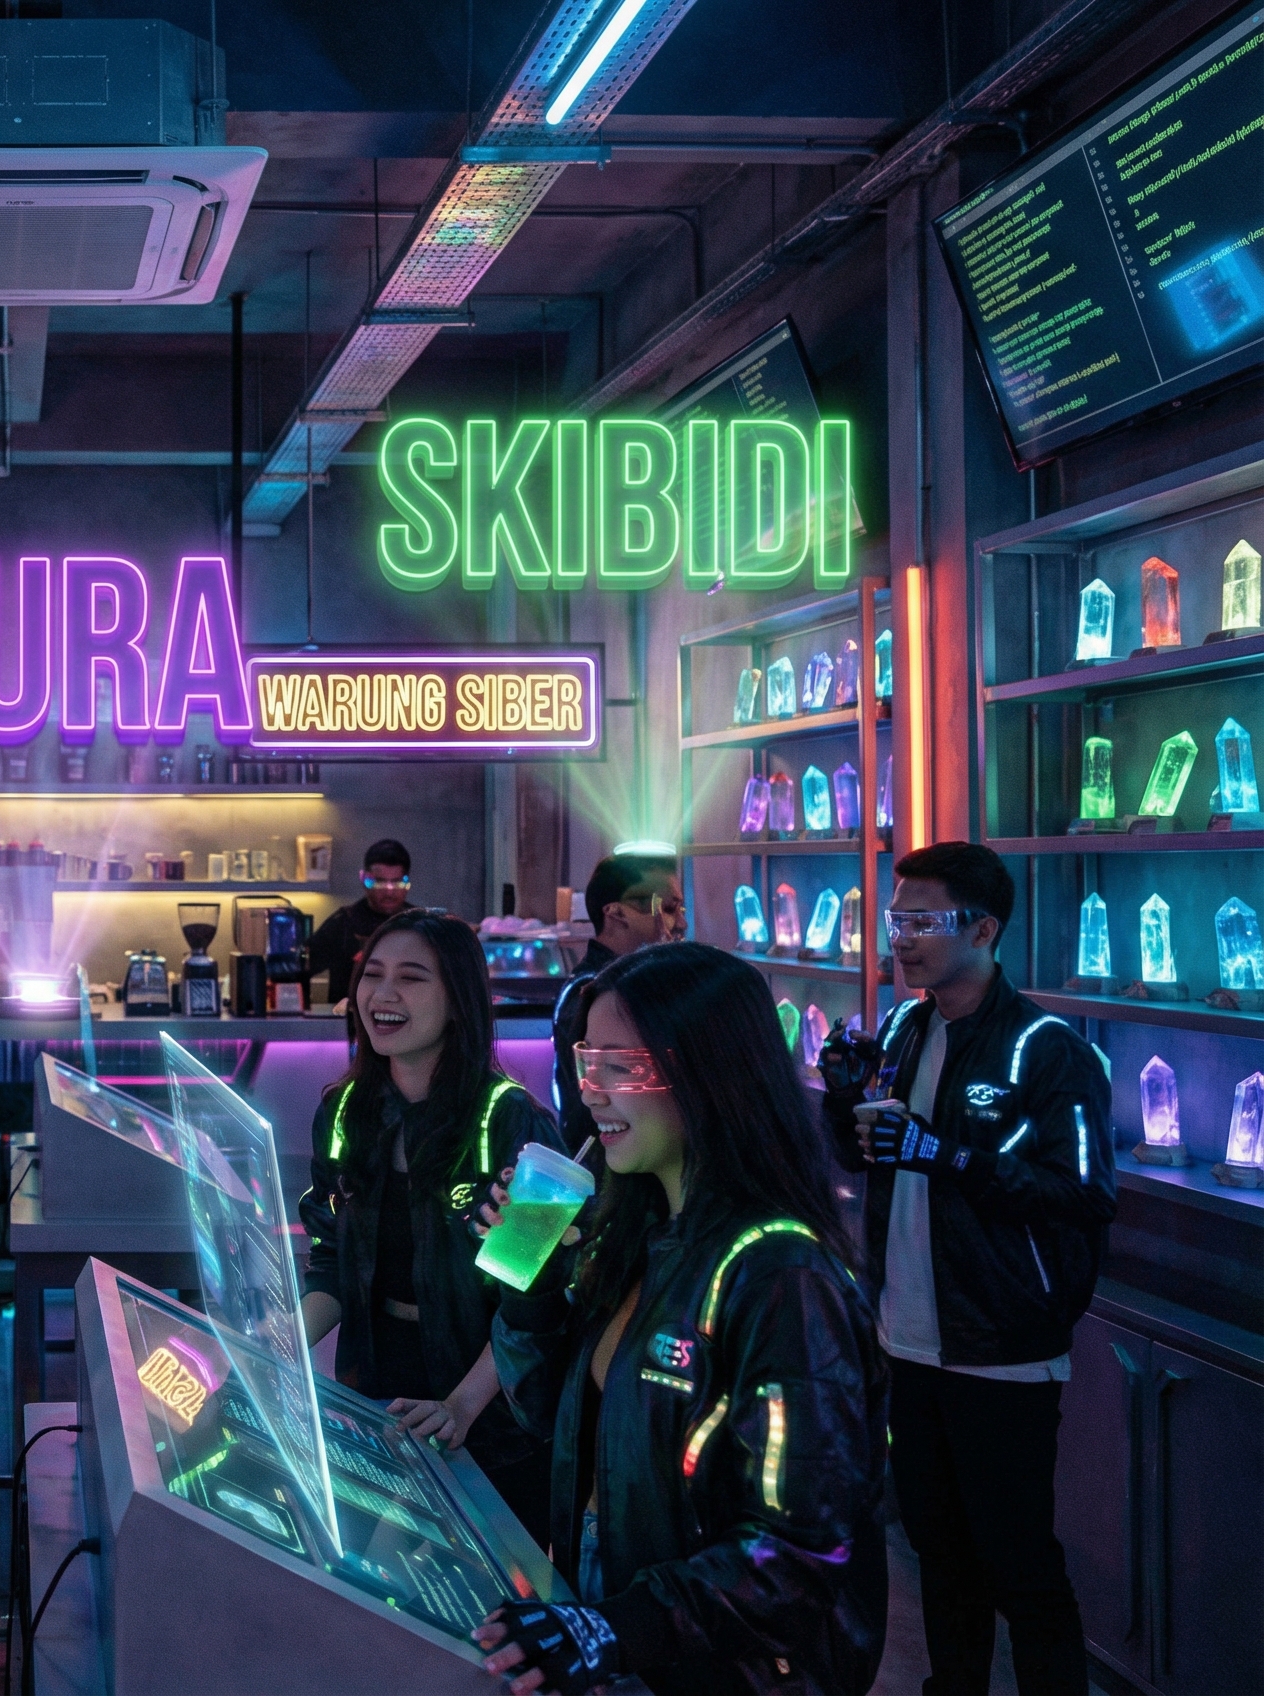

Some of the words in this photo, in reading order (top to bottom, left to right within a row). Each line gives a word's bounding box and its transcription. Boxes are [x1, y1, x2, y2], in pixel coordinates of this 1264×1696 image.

[377, 418, 851, 591] SKIBIDI
[258, 674, 447, 732] WARUNG
[456, 674, 583, 732] SIBER
